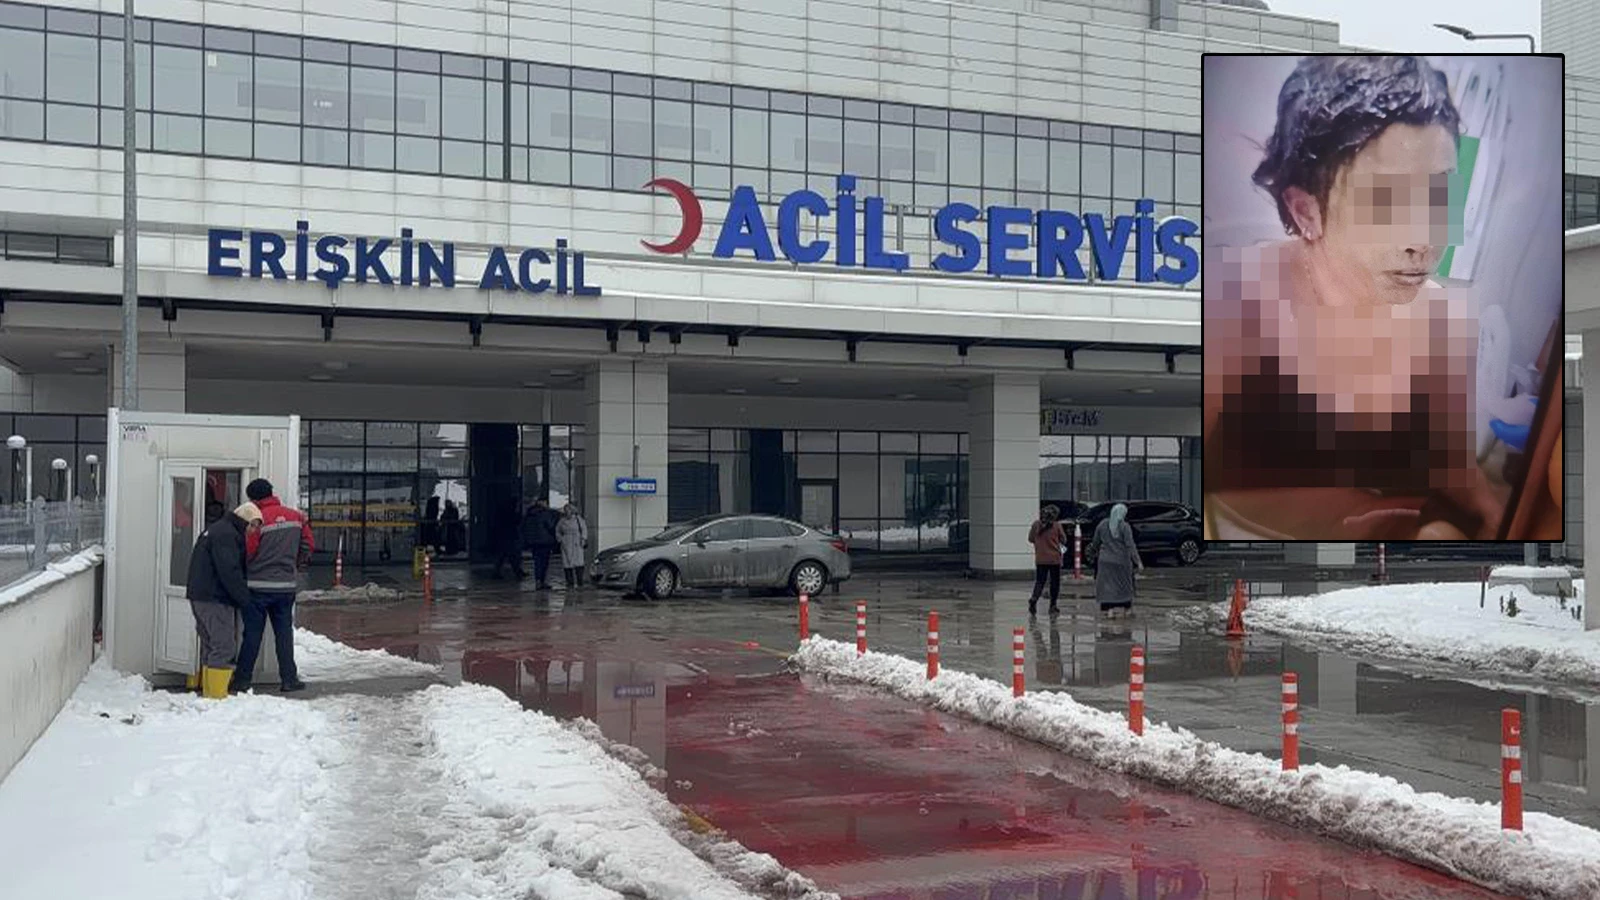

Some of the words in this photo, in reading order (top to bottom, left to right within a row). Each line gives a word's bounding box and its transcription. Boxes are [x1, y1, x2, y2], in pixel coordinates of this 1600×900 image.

[208, 220, 456, 288] ERİŞKİN
[479, 238, 601, 296] ACİL
[713, 175, 909, 270] ACİL
[931, 199, 1199, 284] SERVİS
